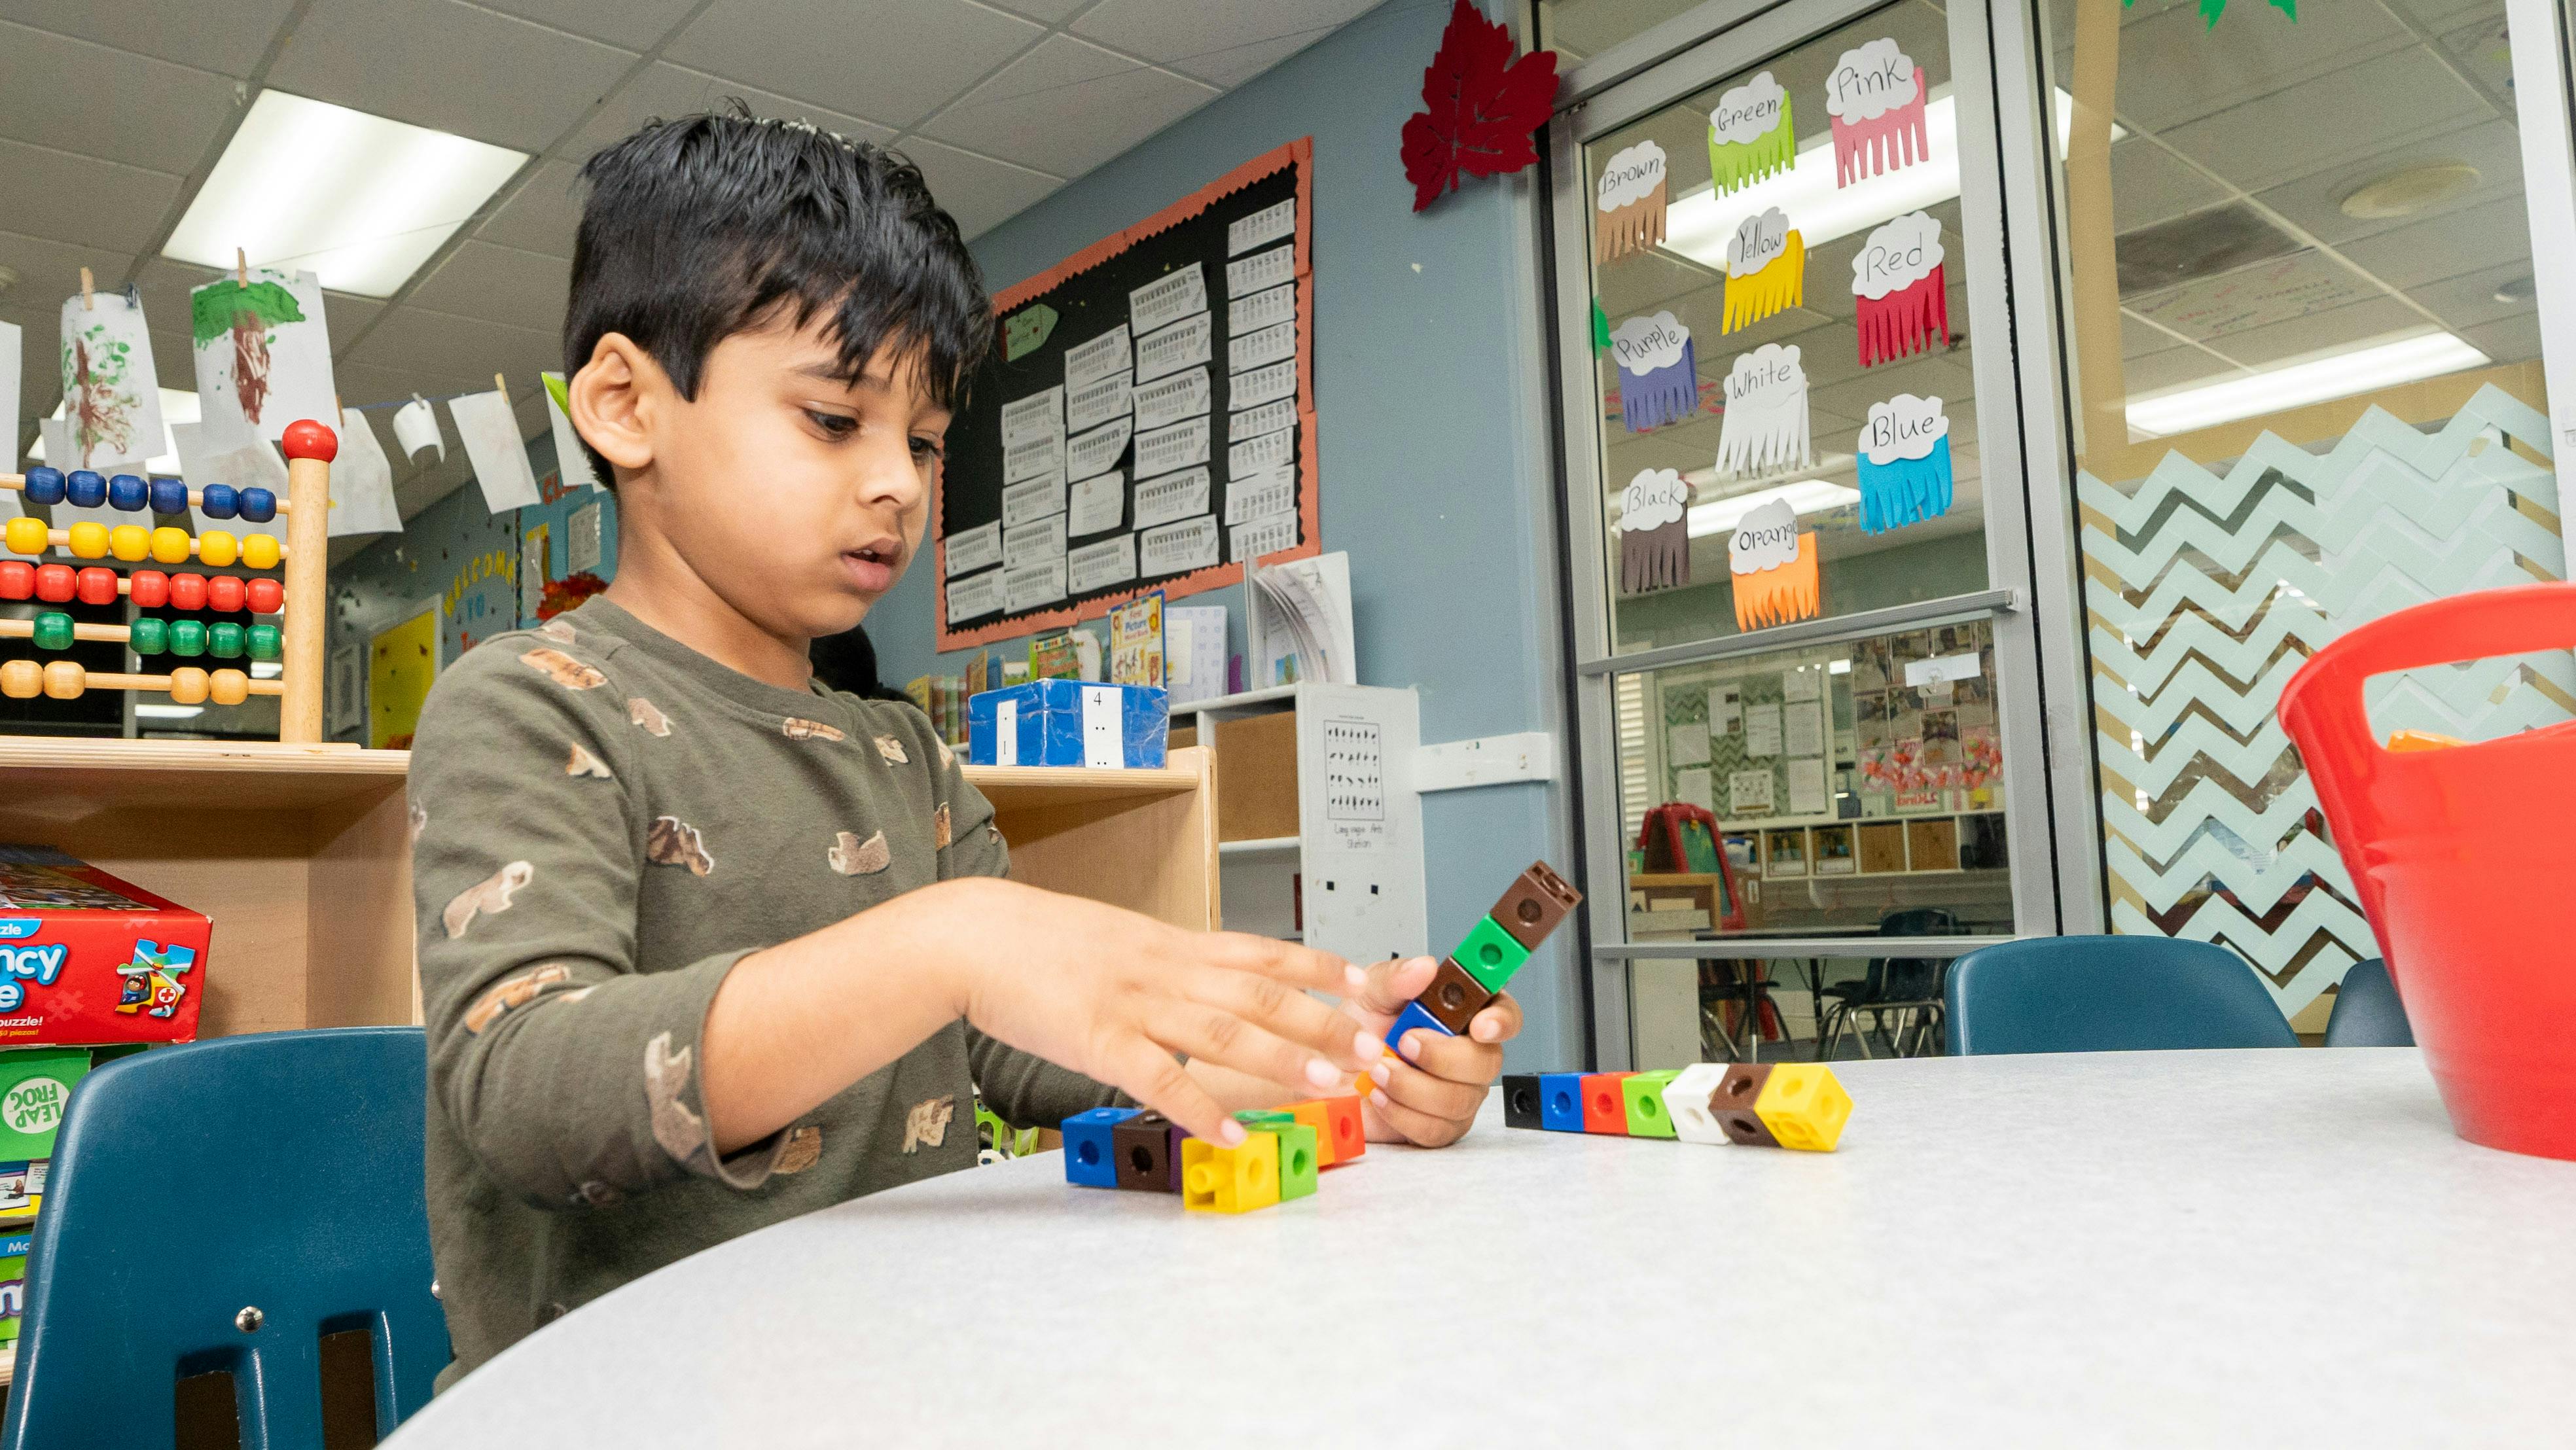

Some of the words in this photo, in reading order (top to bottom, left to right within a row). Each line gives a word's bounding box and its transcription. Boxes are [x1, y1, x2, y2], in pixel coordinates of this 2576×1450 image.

[1837, 58, 1908, 103] Pink
[1718, 99, 1777, 131] Green
[1602, 156, 1660, 194] Brown
[1740, 221, 1782, 262] Yellow
[1867, 233, 1923, 281] Red
[1617, 324, 1680, 362] Purple
[1733, 360, 1791, 399] White
[1872, 412, 1935, 447] Blue
[1624, 478, 1680, 515] Black
[1094, 692, 1101, 706] 4
[10, 1083, 58, 1111] FROG
[15, 1102, 62, 1128] LEAP
